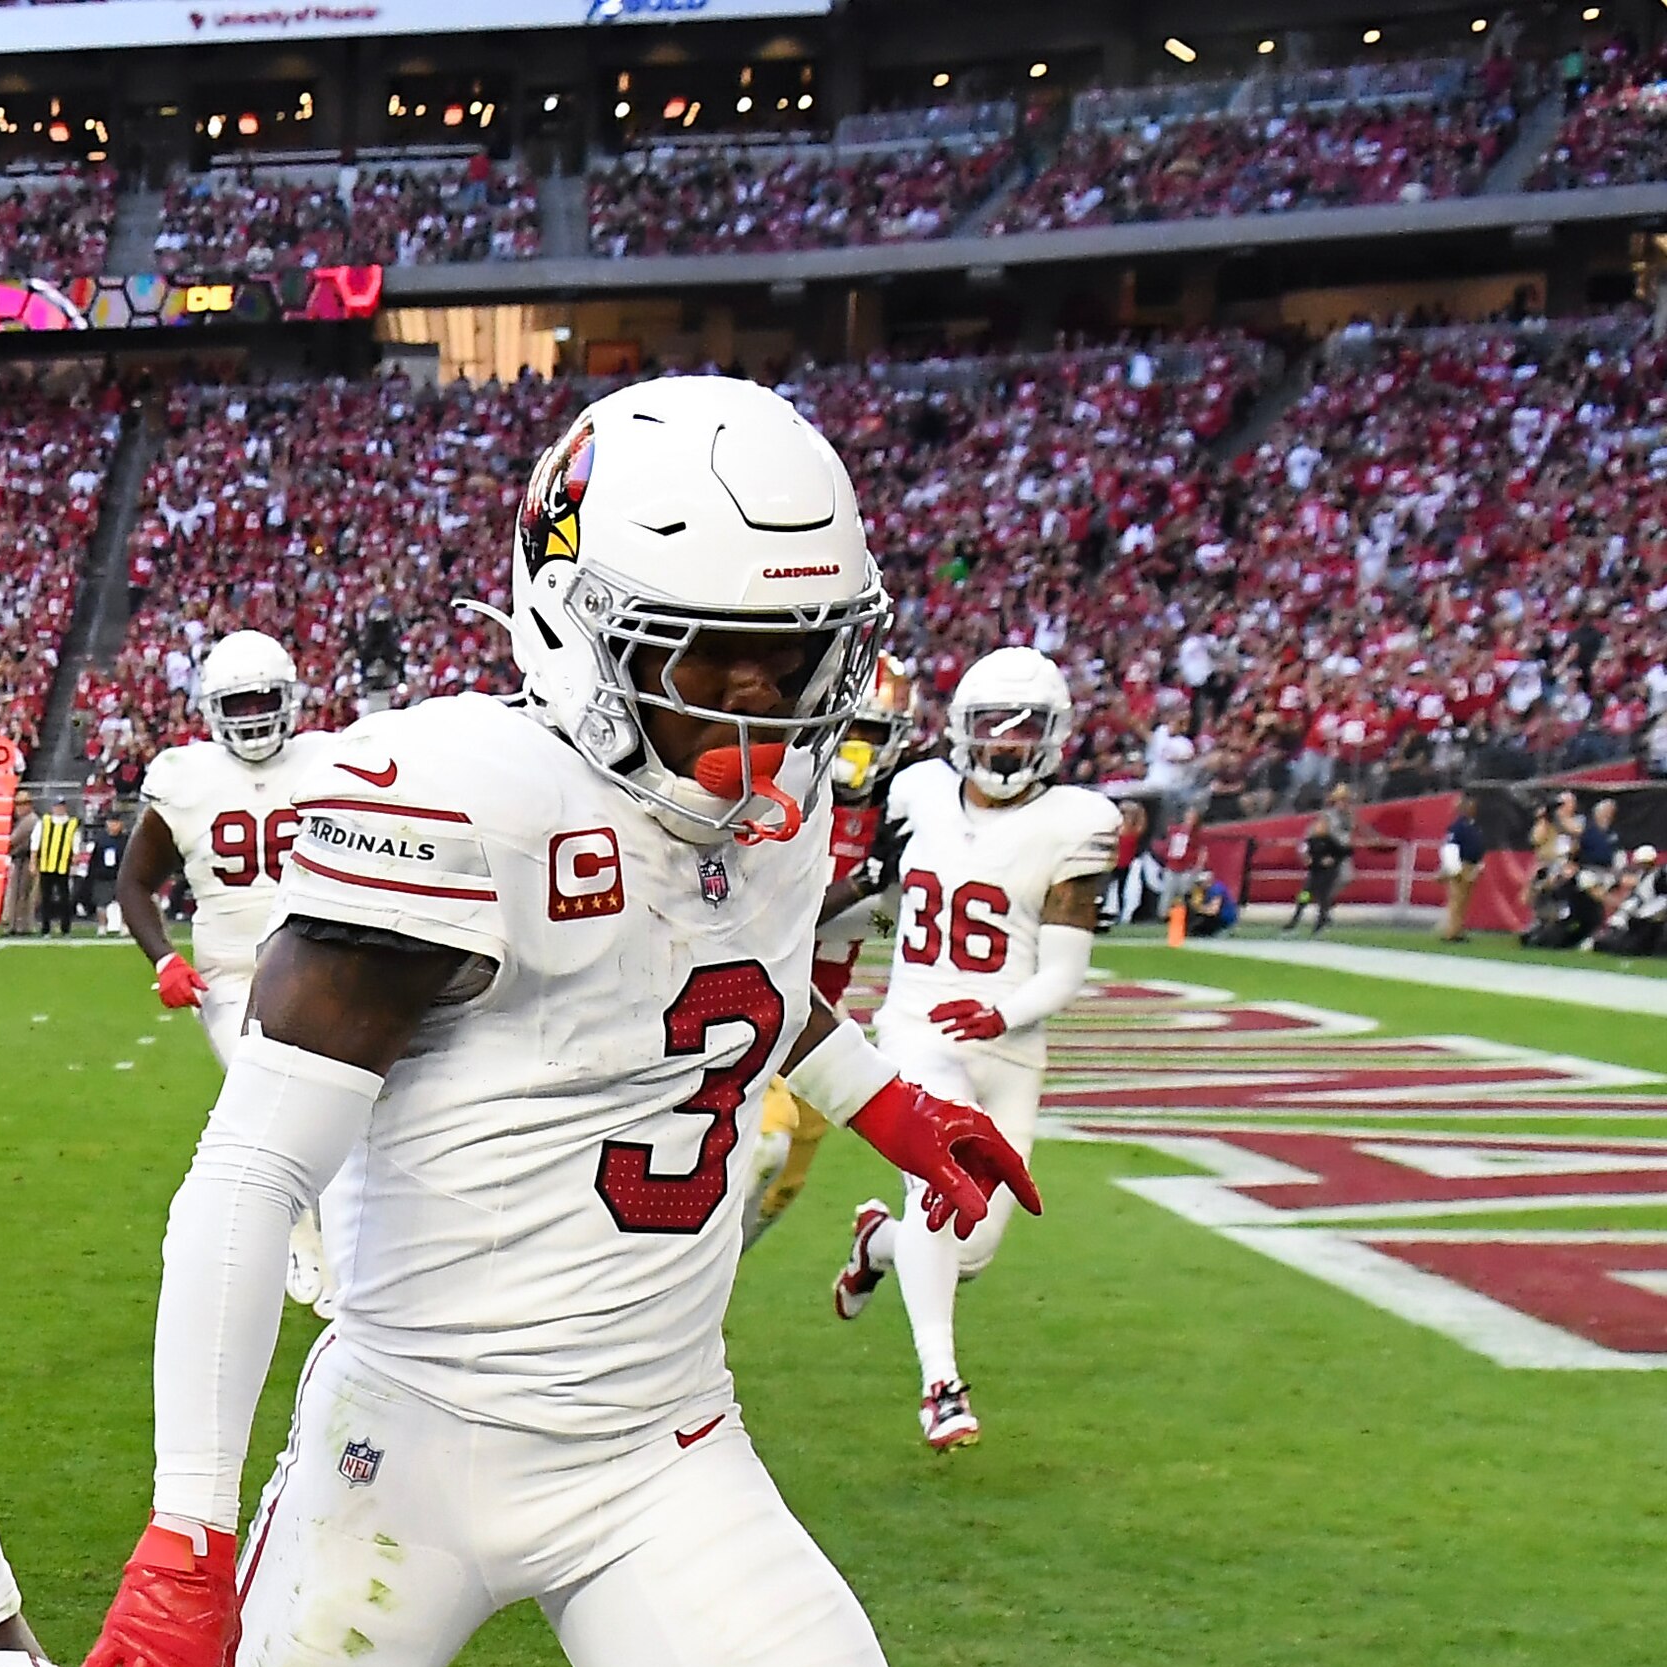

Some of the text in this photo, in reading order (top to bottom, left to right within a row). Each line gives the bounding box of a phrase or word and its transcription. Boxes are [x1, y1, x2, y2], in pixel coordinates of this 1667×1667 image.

[762, 564, 840, 579] CARDINALS
[210, 809, 305, 887] 96
[555, 832, 617, 898] C
[902, 867, 1011, 974] 36
[593, 958, 786, 1235] 3
[343, 1456, 369, 1479] NFL
